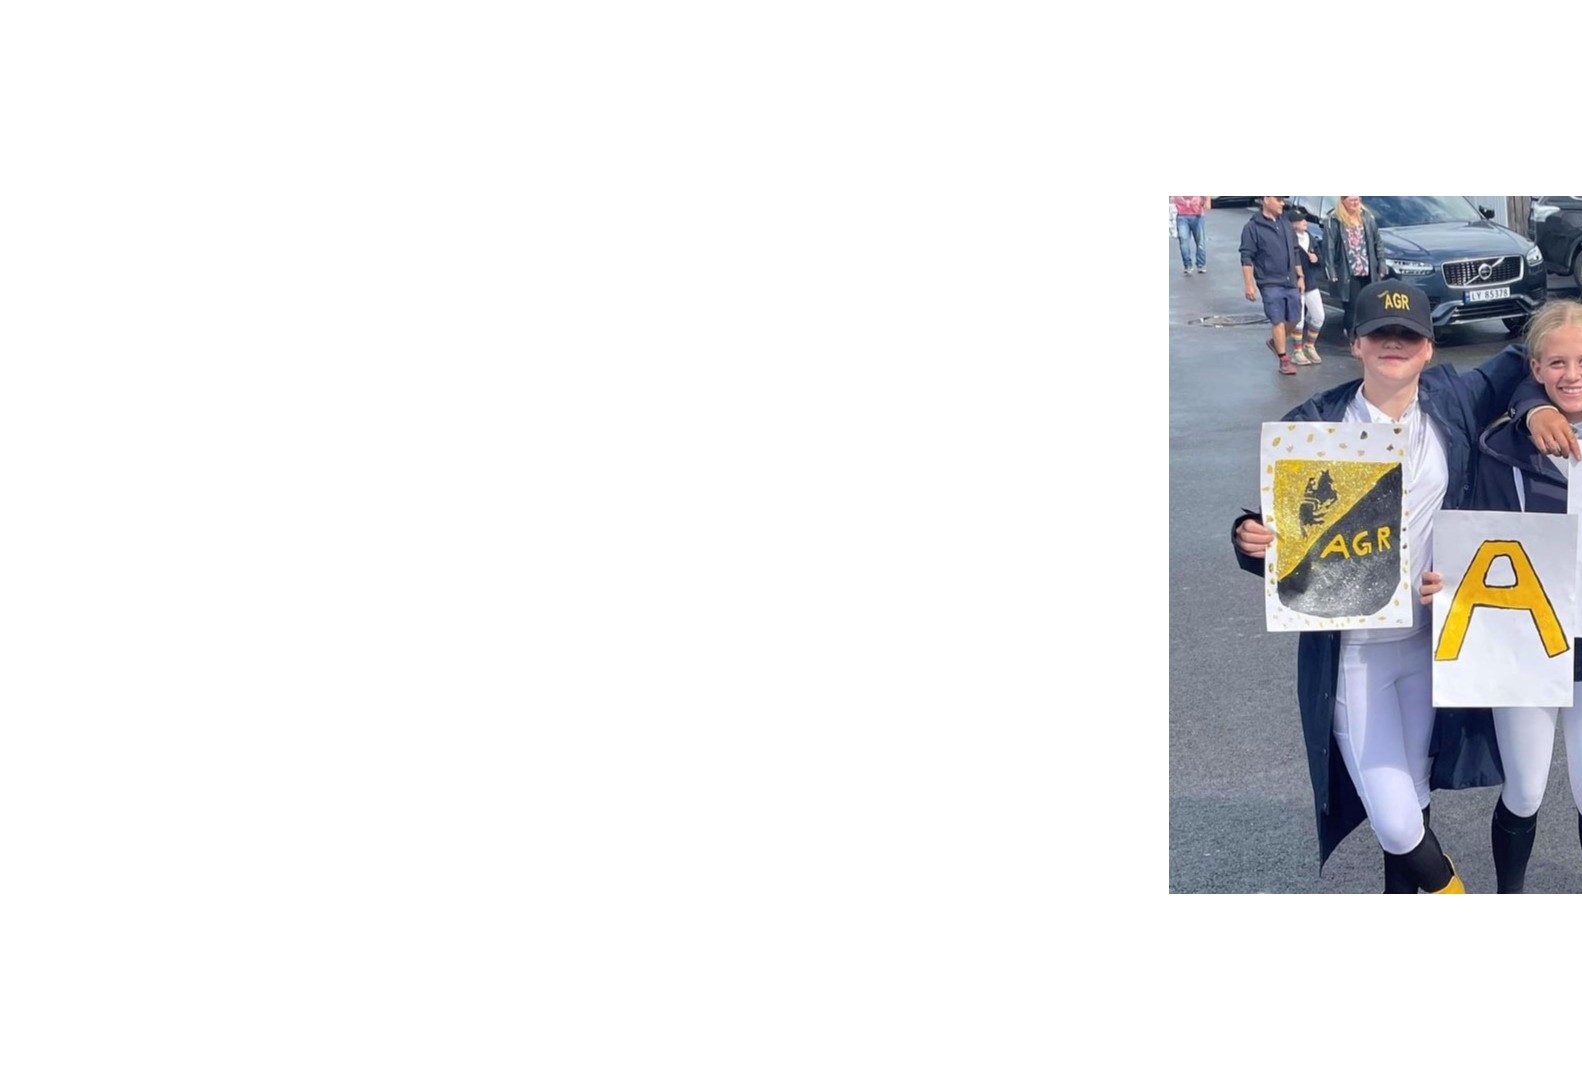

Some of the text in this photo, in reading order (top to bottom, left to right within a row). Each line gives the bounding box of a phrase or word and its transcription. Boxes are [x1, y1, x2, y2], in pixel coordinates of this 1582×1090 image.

[1384, 292, 1411, 310] AGR
[1320, 526, 1392, 560] AGR
[1434, 539, 1570, 661] A
